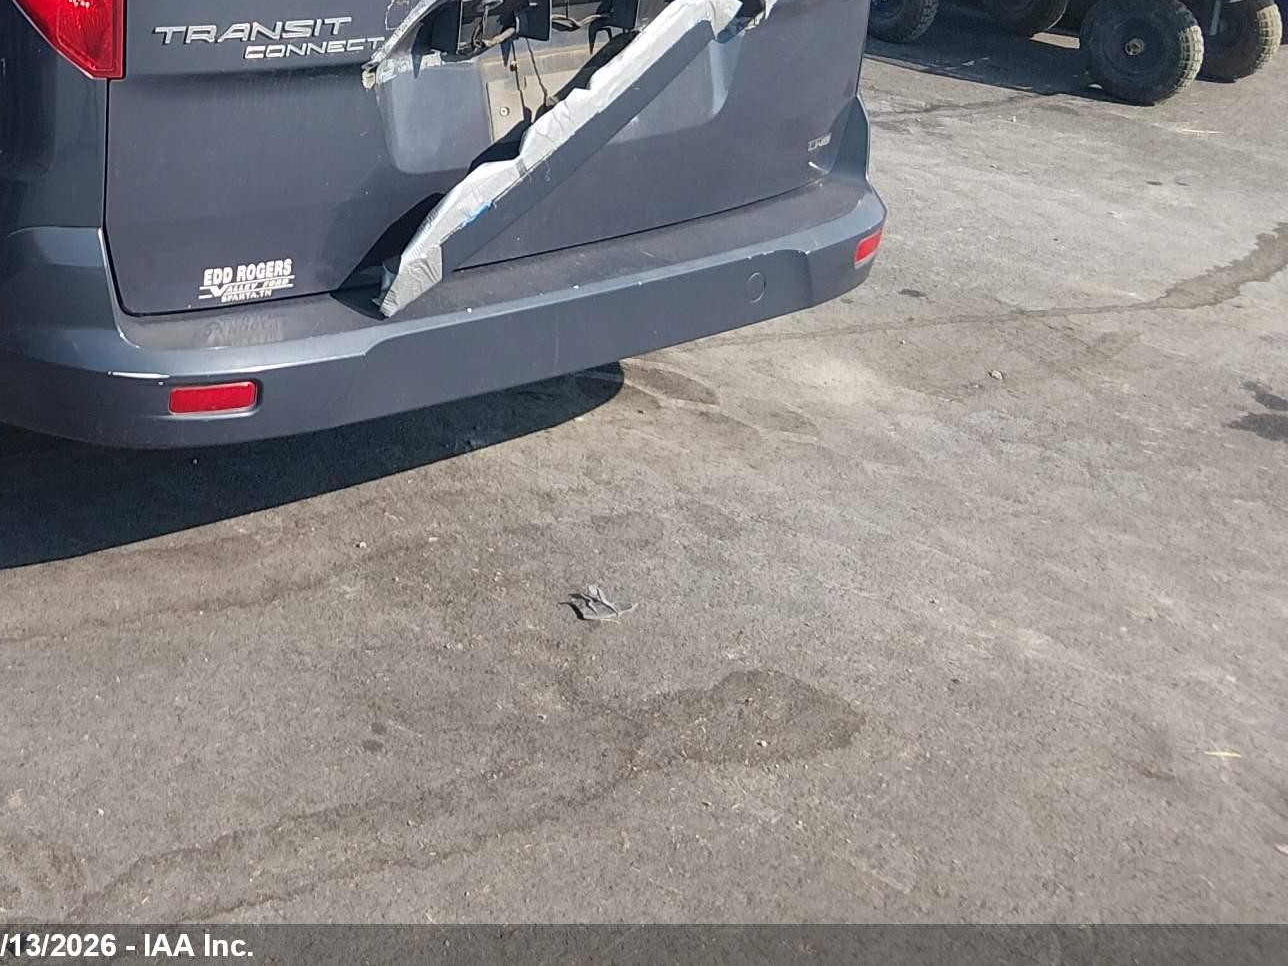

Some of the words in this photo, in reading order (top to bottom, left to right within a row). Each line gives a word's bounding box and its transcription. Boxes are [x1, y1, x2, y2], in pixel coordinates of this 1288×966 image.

[152, 16, 353, 45] TRANSIT
[243, 36, 387, 60] CONNECT
[203, 267, 233, 286] EDD
[236, 258, 293, 282] ROGERS
[262, 278, 291, 290] FORD
